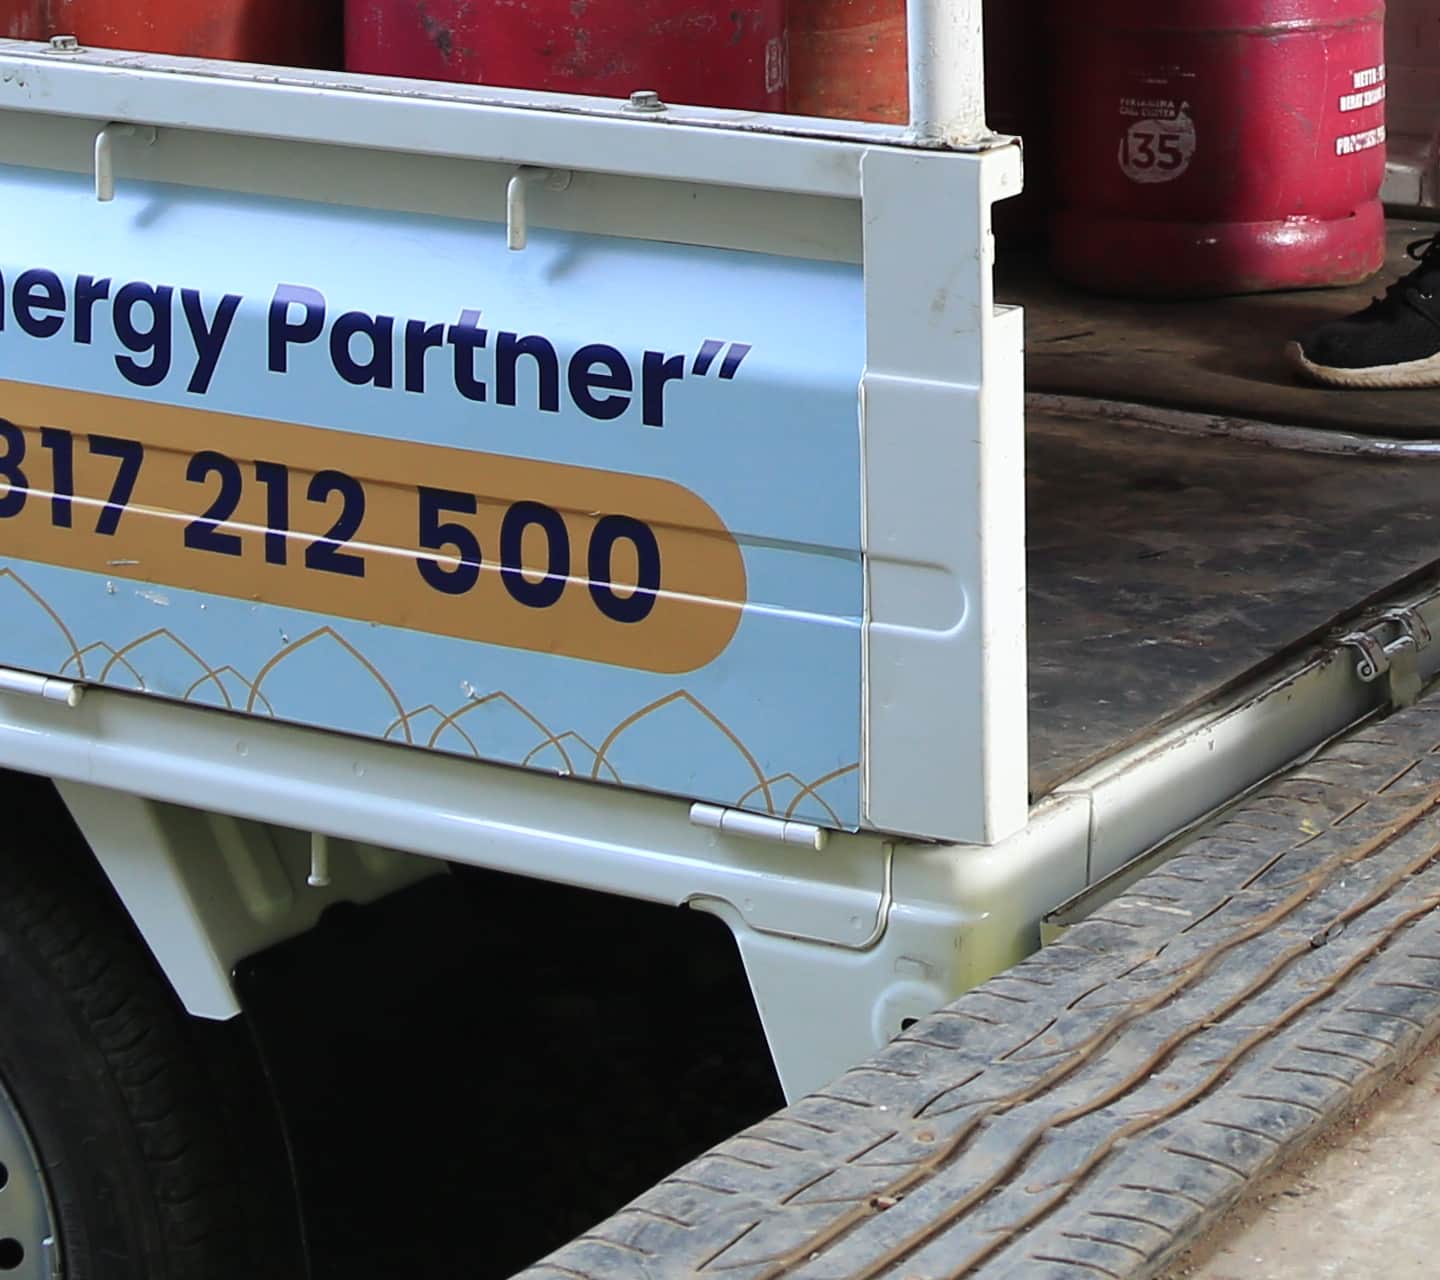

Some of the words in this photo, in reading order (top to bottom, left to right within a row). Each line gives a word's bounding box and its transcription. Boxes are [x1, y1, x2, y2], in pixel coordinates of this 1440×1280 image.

[1122, 131, 1185, 171] 135
[183, 449, 366, 578] 212
[416, 484, 661, 624] 500
